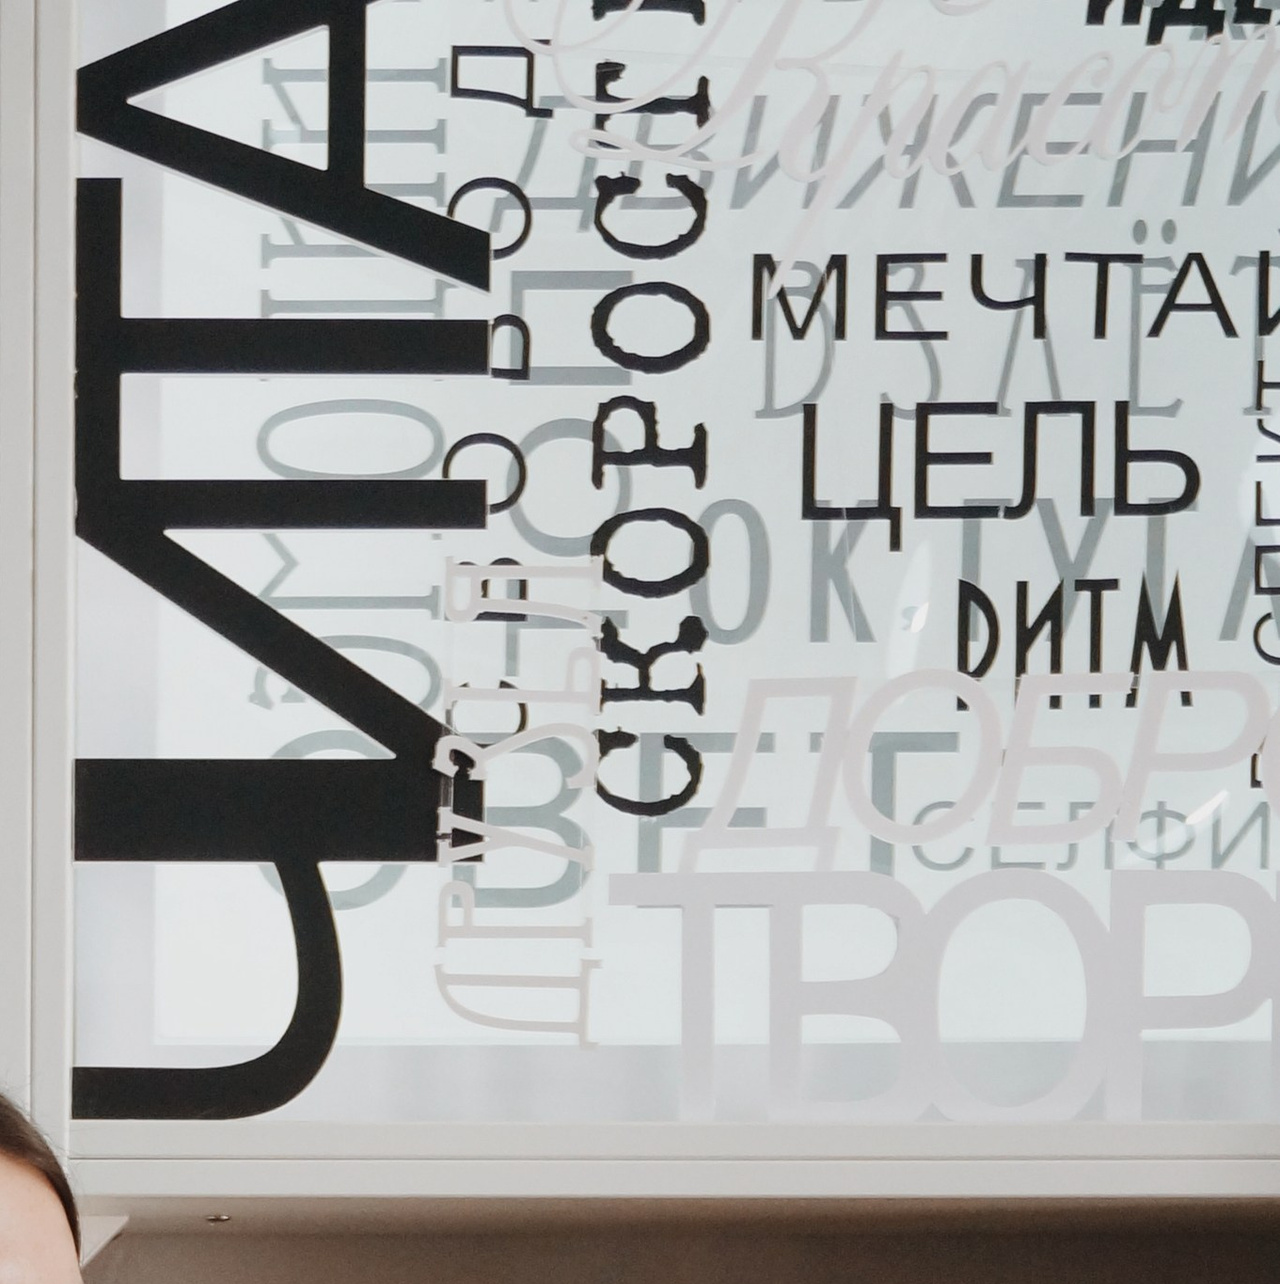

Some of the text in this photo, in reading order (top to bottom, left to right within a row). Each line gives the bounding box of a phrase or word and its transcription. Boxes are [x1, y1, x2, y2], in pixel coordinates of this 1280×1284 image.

[588, 0, 710, 818] СКОРОСТ
[802, 400, 1202, 552] ЦЕЛЬ
[436, 556, 605, 1050] ДРУЗЬЯ
[678, 667, 1280, 880] ДОБР
